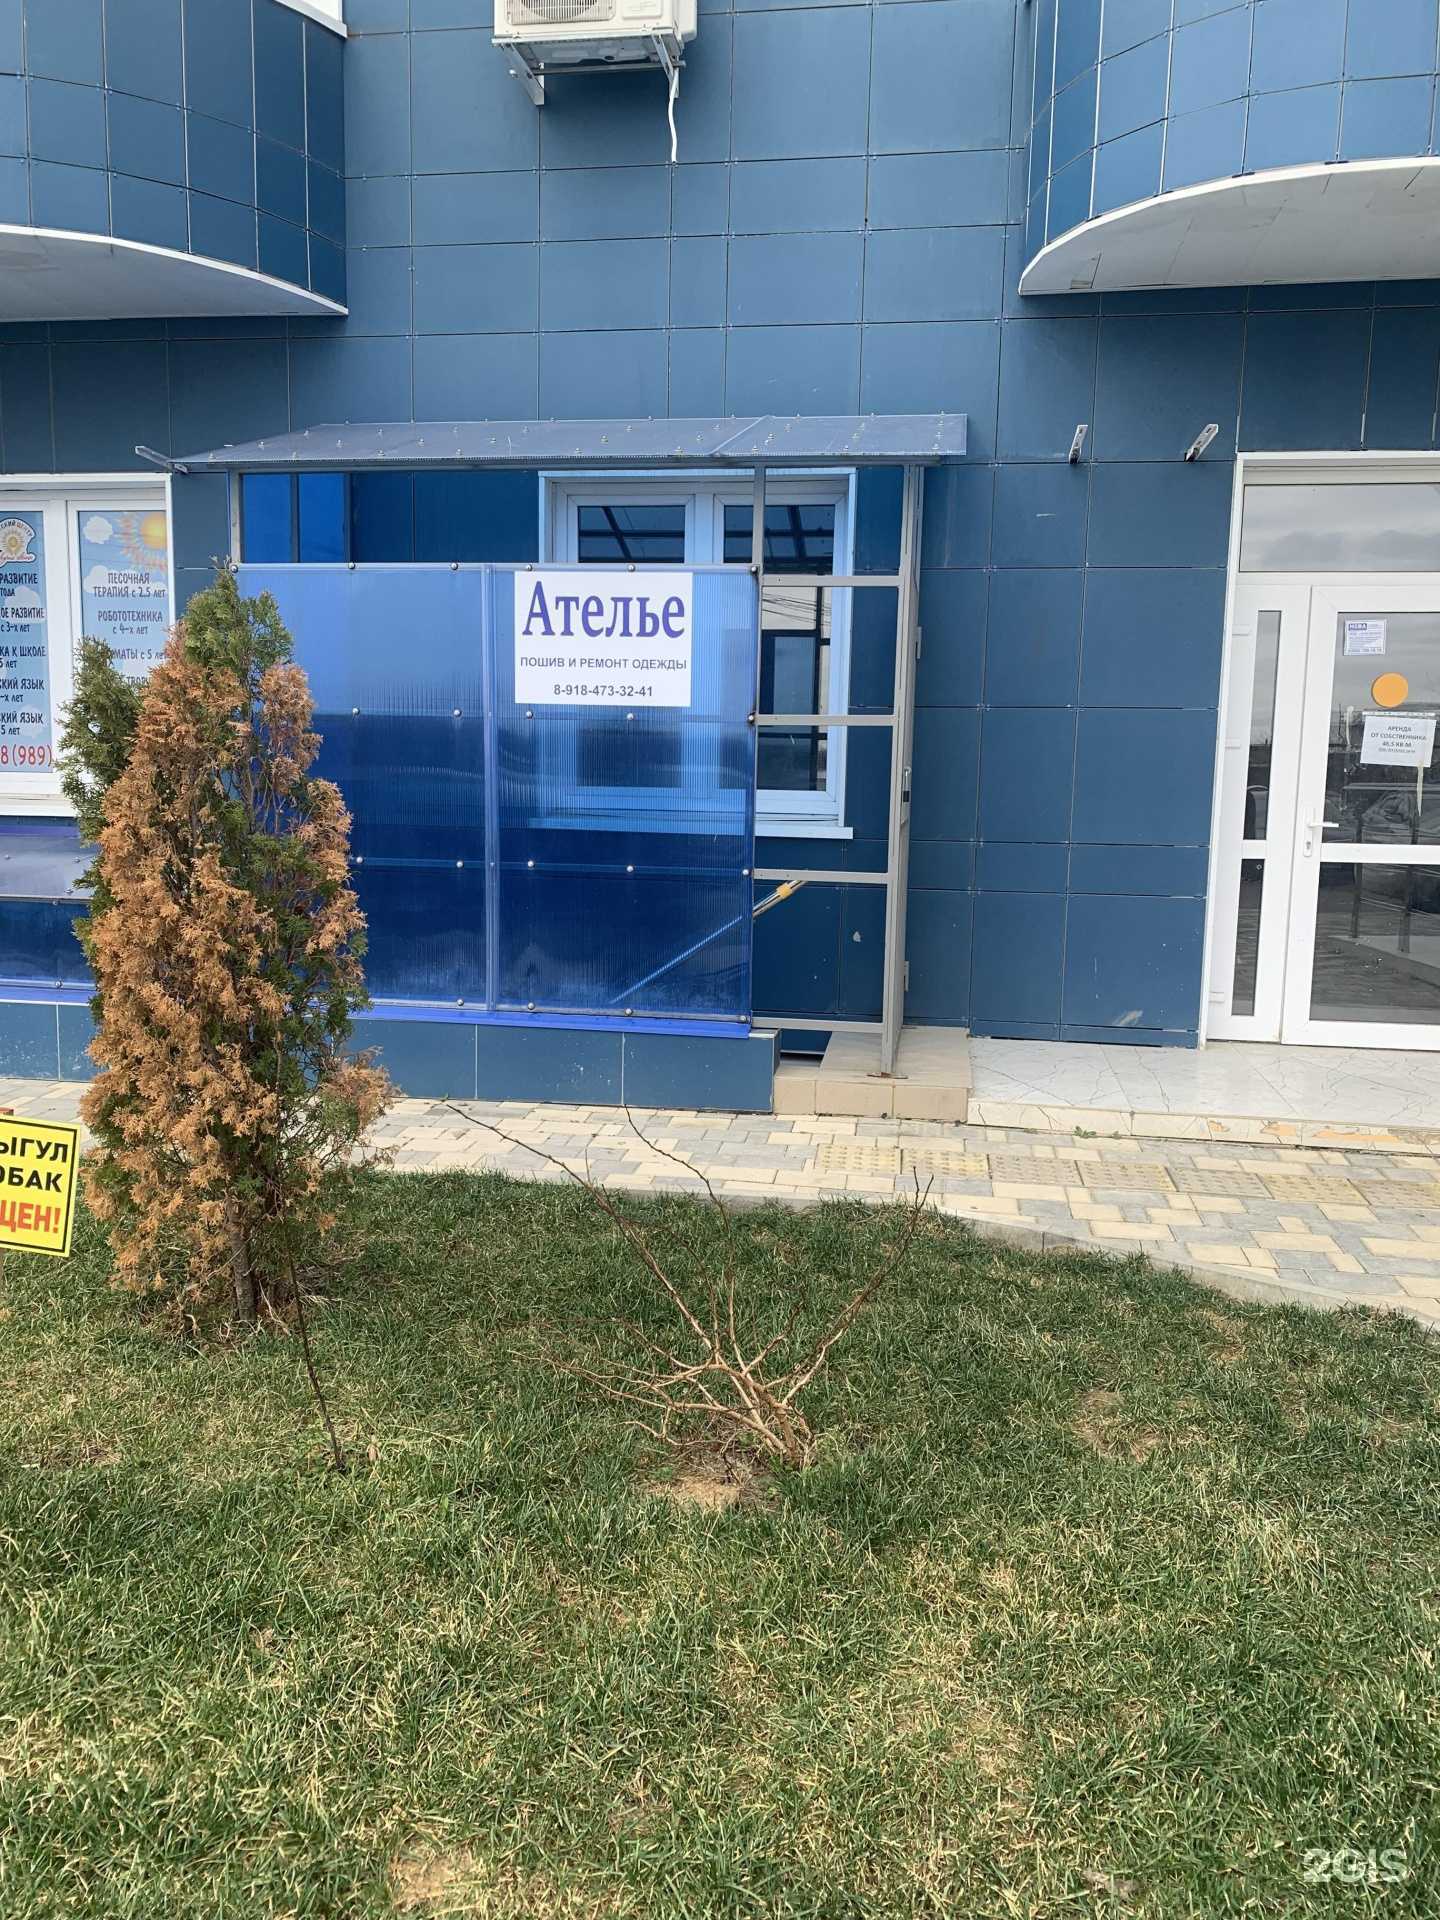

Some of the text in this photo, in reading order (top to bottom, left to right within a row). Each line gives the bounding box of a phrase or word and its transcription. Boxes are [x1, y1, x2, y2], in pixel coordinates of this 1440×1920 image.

[0, 572, 38, 584] РАЗВИТИЕ
[108, 573, 150, 584] ПЕСОЧНАЯ
[94, 586, 129, 598] ТЕРАПИЯ
[11, 607, 45, 618] РАЗВИТИЕ
[522, 580, 685, 639] Ателье
[98, 610, 163, 622] РОБОТОТЕХНИКА
[20, 624, 31, 632] лет
[136, 626, 149, 635] лет
[20, 646, 46, 657] ШКОЛЕ
[147, 649, 152, 659] 5
[6, 660, 17, 668] лет
[520, 656, 687, 671] ПОШИВ И РЕМОНТ ОДЕЖДЫ
[21, 678, 44, 690] ЯЗЫК
[553, 684, 653, 697] 8-918-473-32-41
[11, 694, 24, 702] лет
[20, 712, 43, 724] ЯЗЫК
[8, 727, 20, 735] лет
